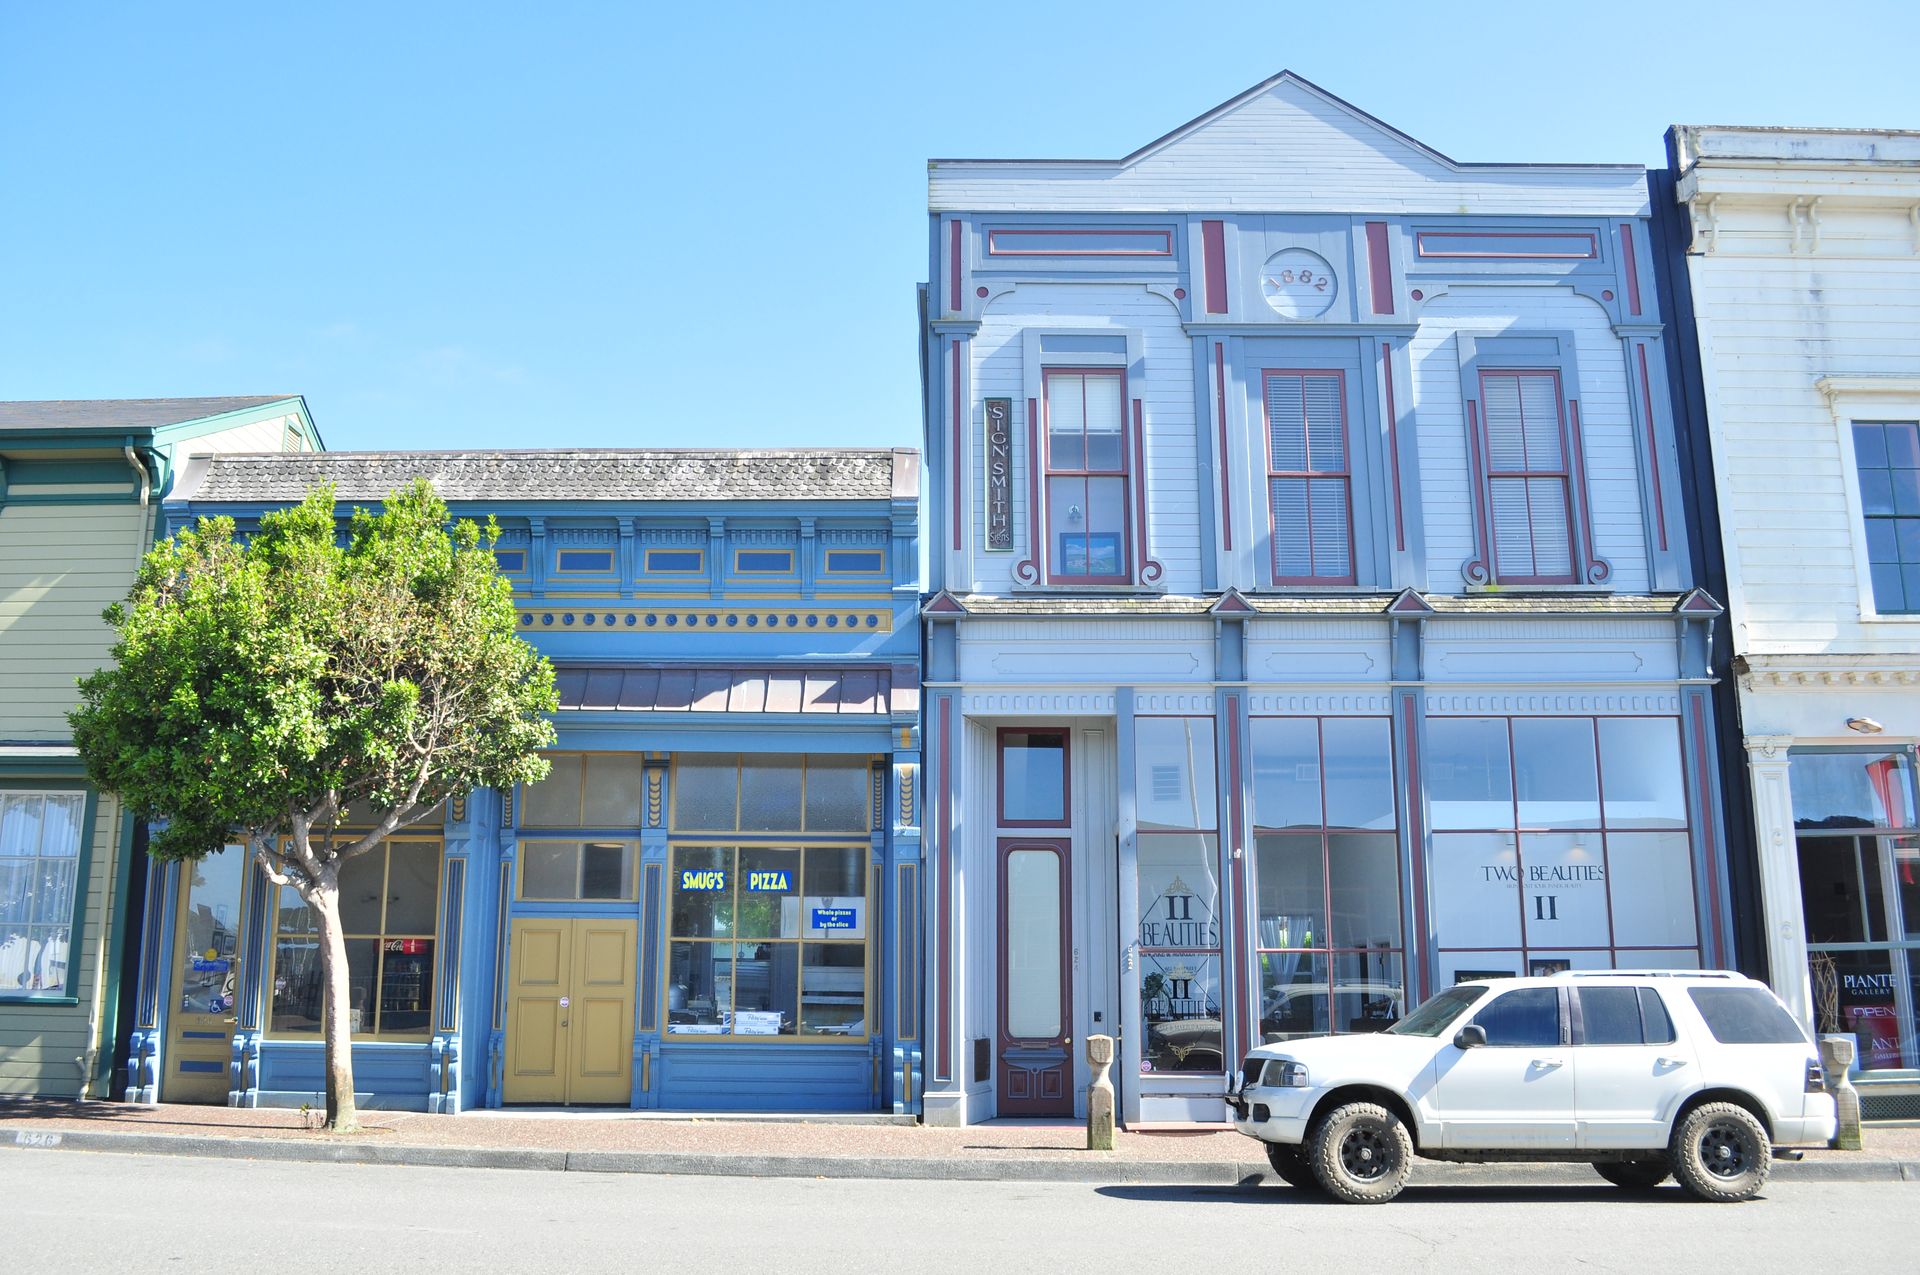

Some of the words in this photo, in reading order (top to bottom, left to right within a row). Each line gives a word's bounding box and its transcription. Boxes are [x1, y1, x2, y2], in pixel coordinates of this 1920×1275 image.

[1267, 269, 1328, 292] 1882
[991, 462, 1006, 527] SMITH
[682, 871, 724, 890] SMUG'S
[750, 872, 788, 890] PIZZA
[1530, 865, 1605, 881] BEAUTIES
[1165, 895, 1193, 921] II
[1534, 895, 1559, 921] II
[1142, 922, 1218, 947] BEAUTIES
[1843, 974, 1897, 989] PIANTE
[1853, 1006, 1896, 1017] OPEN
